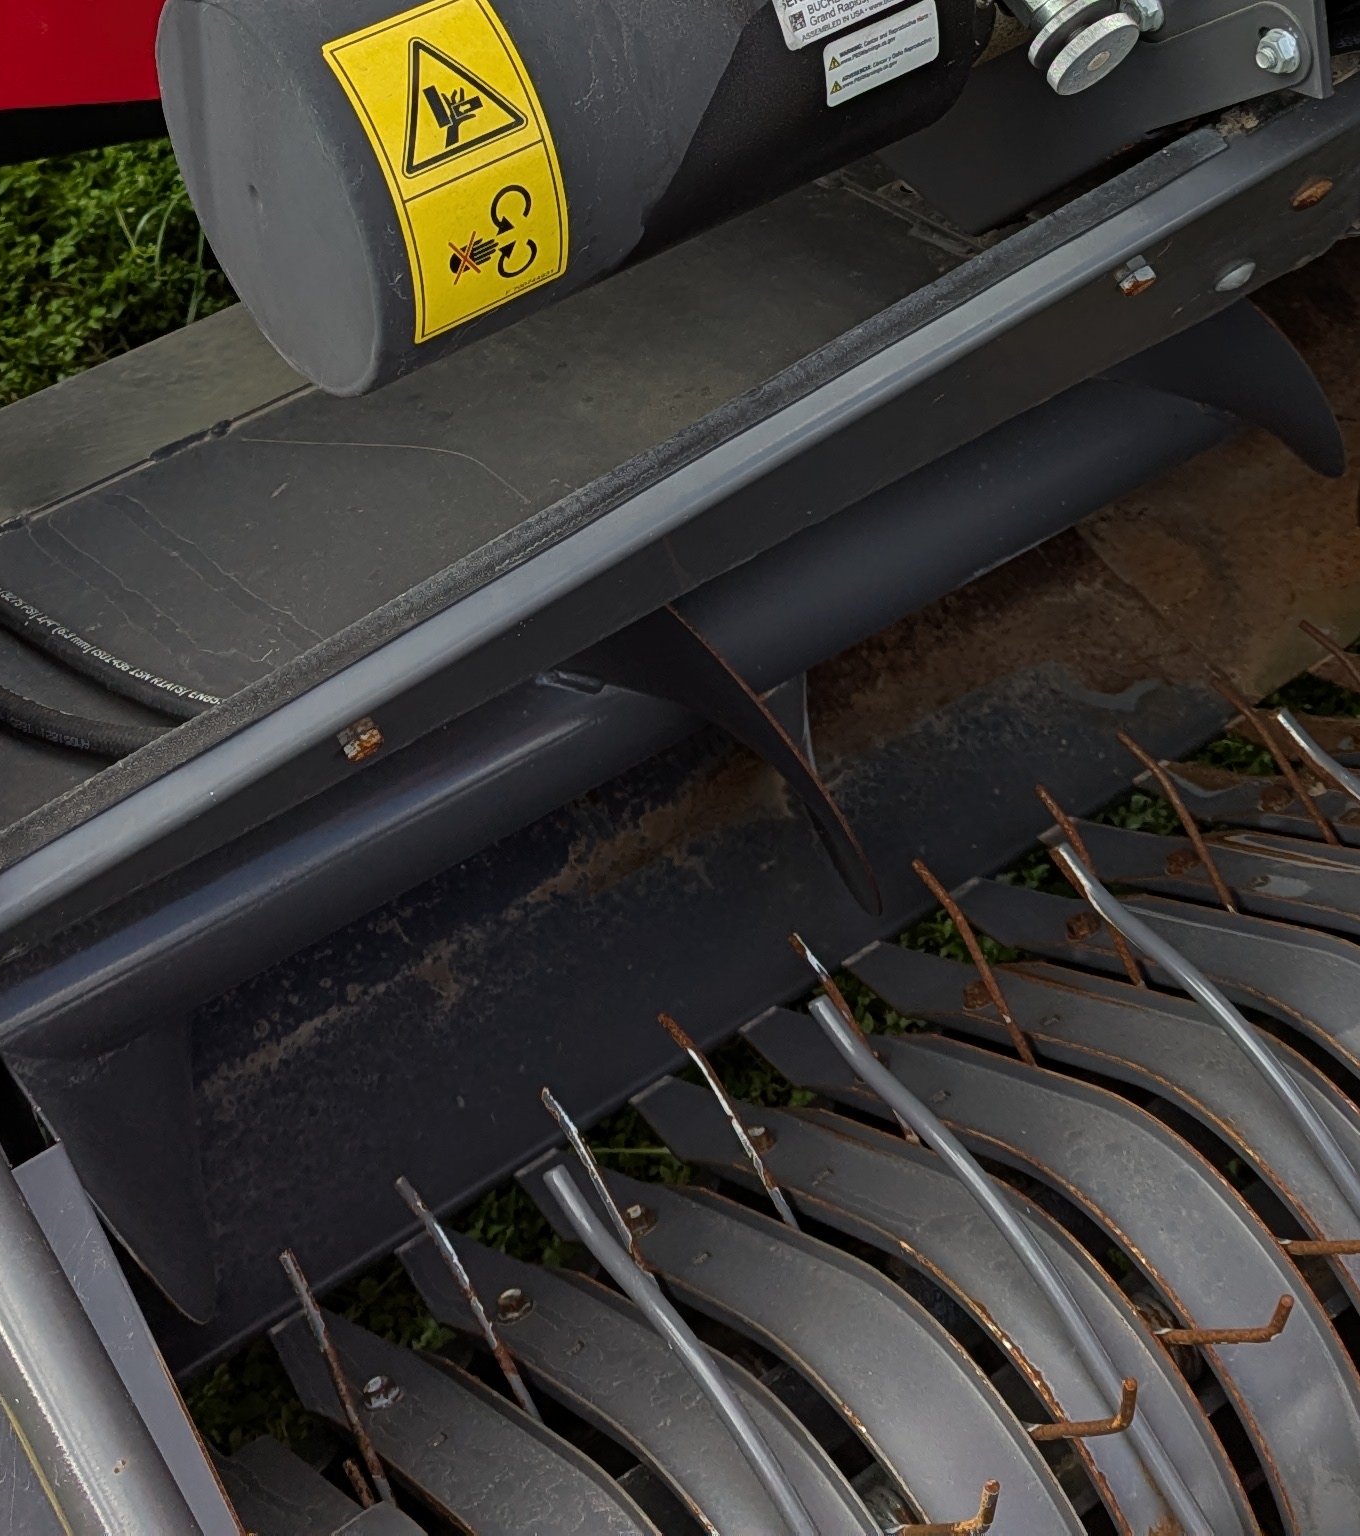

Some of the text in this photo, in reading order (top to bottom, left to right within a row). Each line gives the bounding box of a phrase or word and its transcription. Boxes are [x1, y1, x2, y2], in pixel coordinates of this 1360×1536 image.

[801, 20, 841, 42] ASSEMBLED
[850, 8, 865, 20] USA
[809, 7, 836, 27] Grand
